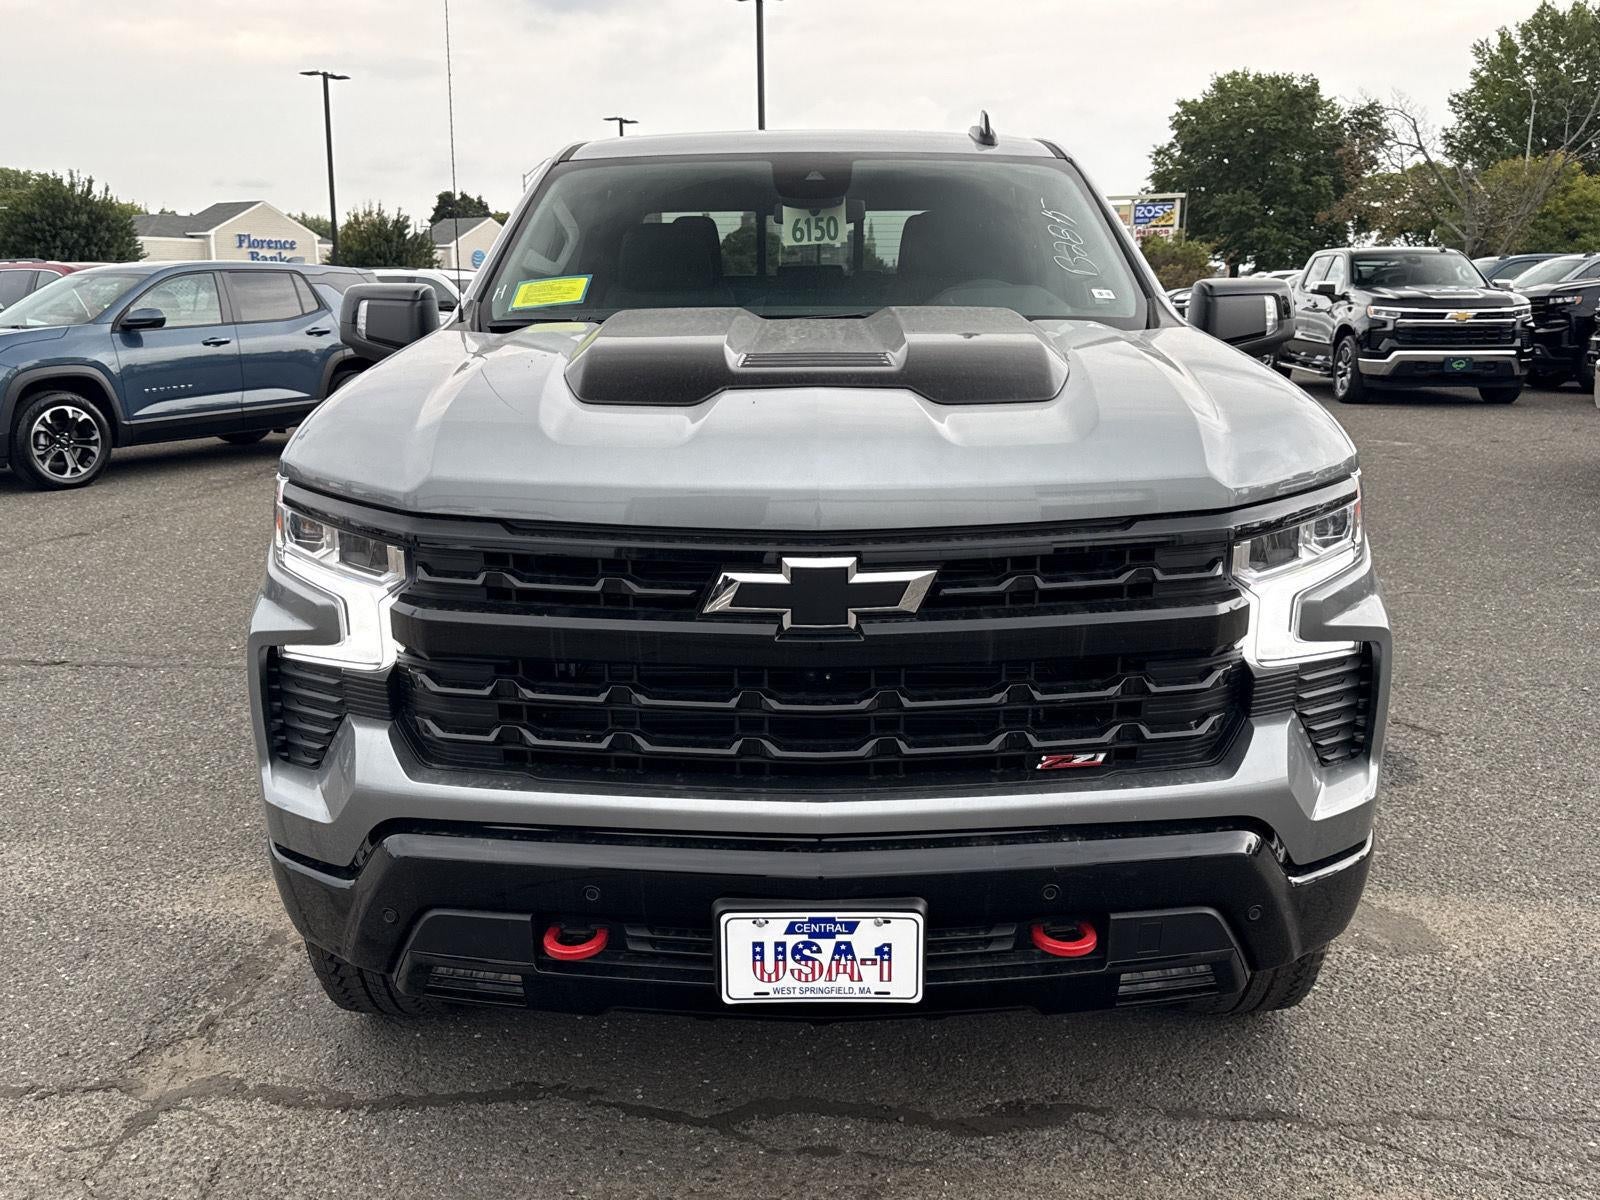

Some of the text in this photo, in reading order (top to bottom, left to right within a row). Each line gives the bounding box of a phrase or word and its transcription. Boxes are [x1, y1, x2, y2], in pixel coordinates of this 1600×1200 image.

[1135, 205, 1173, 217] ROSS
[791, 215, 839, 243] 6150
[236, 233, 297, 250] Florence
[794, 923, 849, 933] CENTRAL
[752, 940, 892, 983] USA-1
[772, 986, 872, 996] WEST SPRINGFIELD, MA
